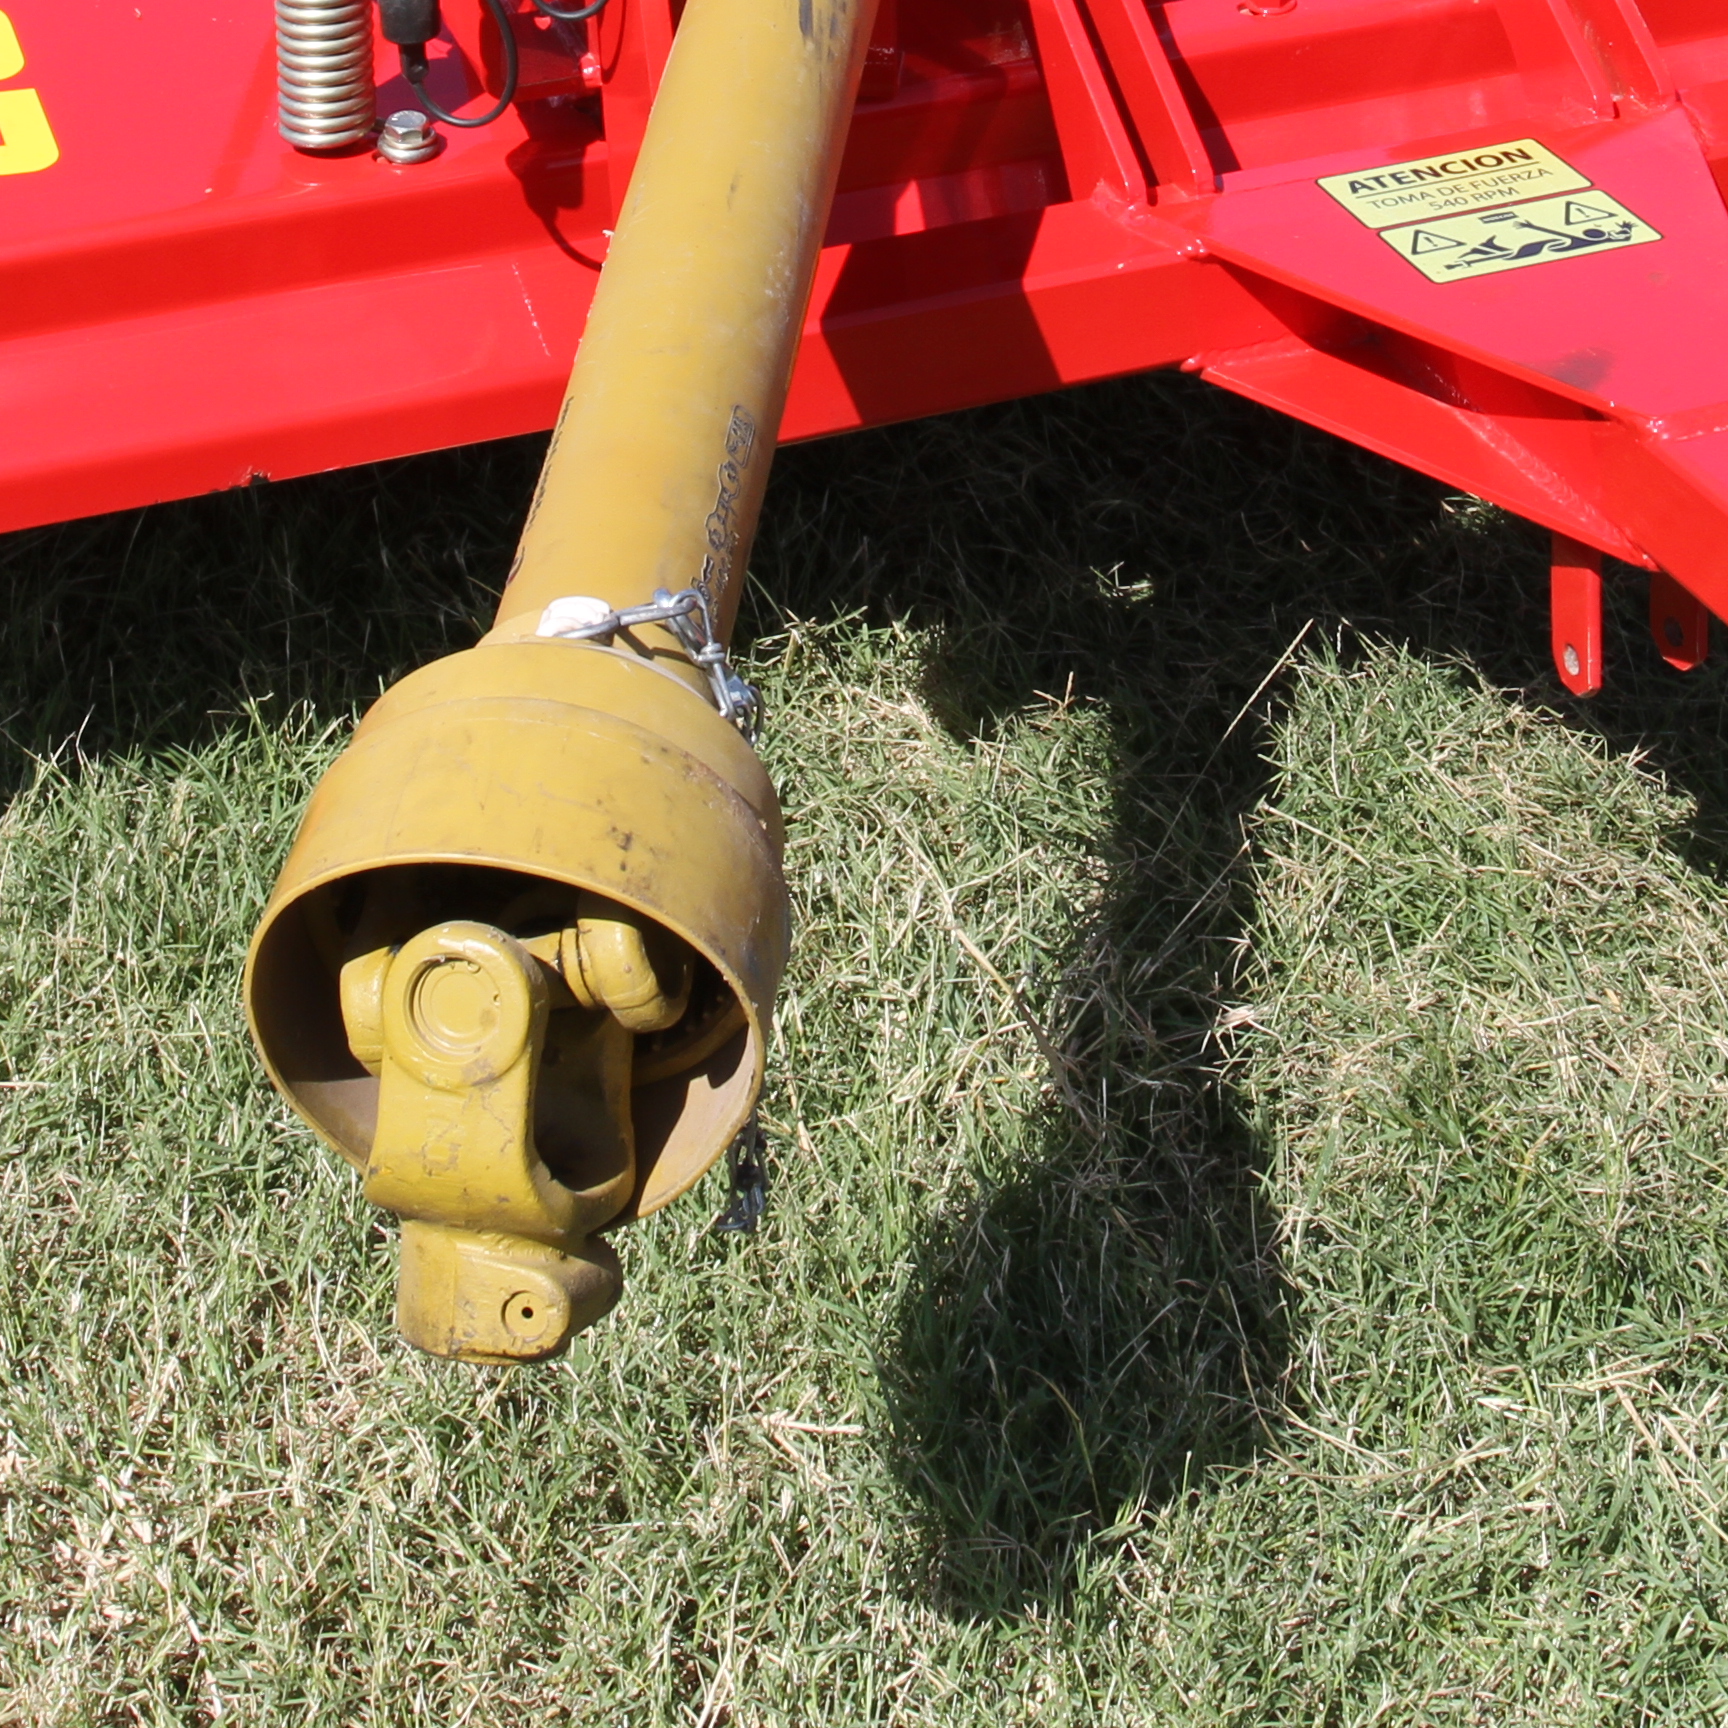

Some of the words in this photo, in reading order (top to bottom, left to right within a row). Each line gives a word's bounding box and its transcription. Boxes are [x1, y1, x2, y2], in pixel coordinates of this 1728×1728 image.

[1348, 148, 1534, 194] ATENCION
[1366, 189, 1434, 210] TOMA
[1437, 182, 1470, 197] DE
[1469, 168, 1554, 190] FUERZA
[1428, 197, 1469, 211] 540
[1472, 186, 1521, 203] RPM
